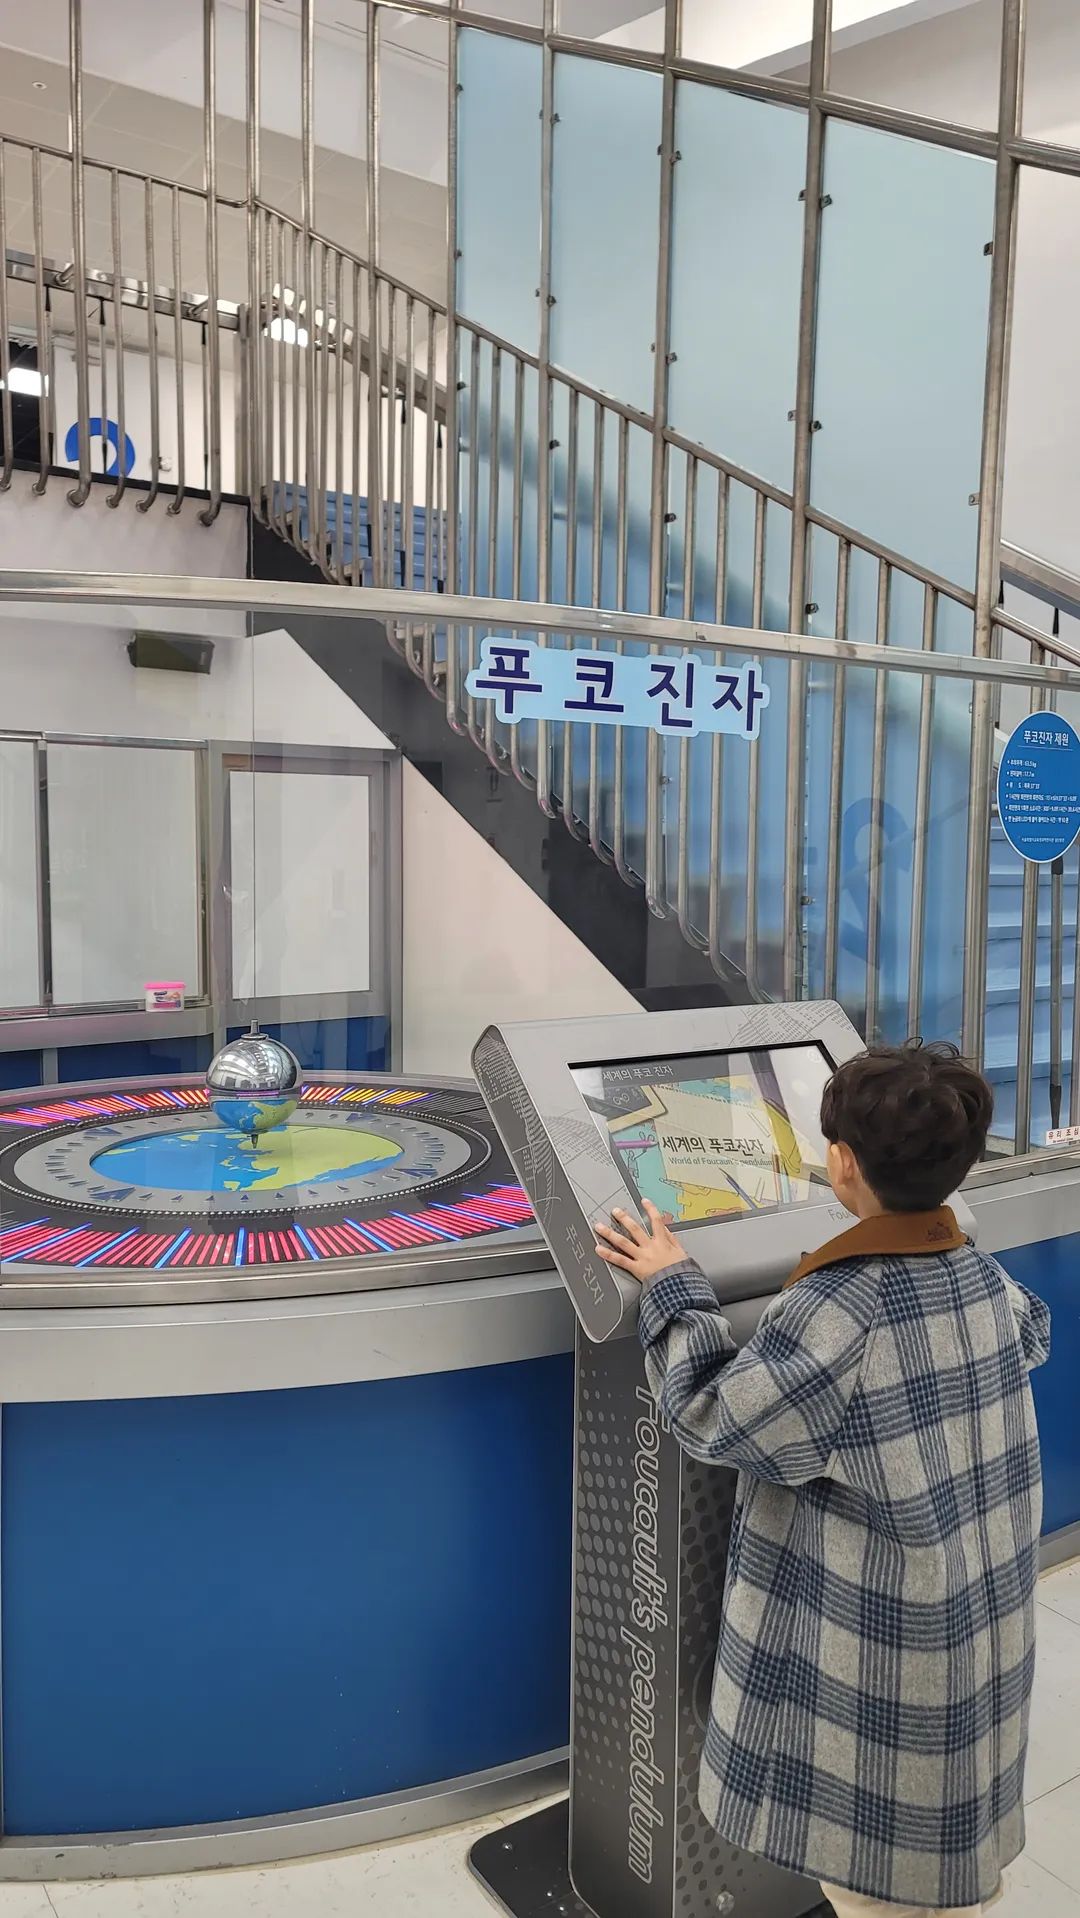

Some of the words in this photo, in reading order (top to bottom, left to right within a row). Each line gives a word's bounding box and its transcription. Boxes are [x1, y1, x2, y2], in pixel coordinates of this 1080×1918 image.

[475, 645, 764, 732] 푸코진자
[1023, 730, 1053, 745] 푸코진자
[1054, 732, 1069, 746] 제원
[602, 1068, 632, 1081] 세계의
[633, 1067, 651, 1078] 푸코
[654, 1065, 673, 1077] 진자
[662, 1136, 704, 1154] 세계의
[710, 1136, 765, 1157] 푸코진자
[668, 1157, 692, 1165] World
[693, 1157, 701, 1165] of
[566, 1223, 586, 1265] 푸코
[583, 1263, 604, 1305] 진자
[620, 1626, 665, 1884] pendulum
